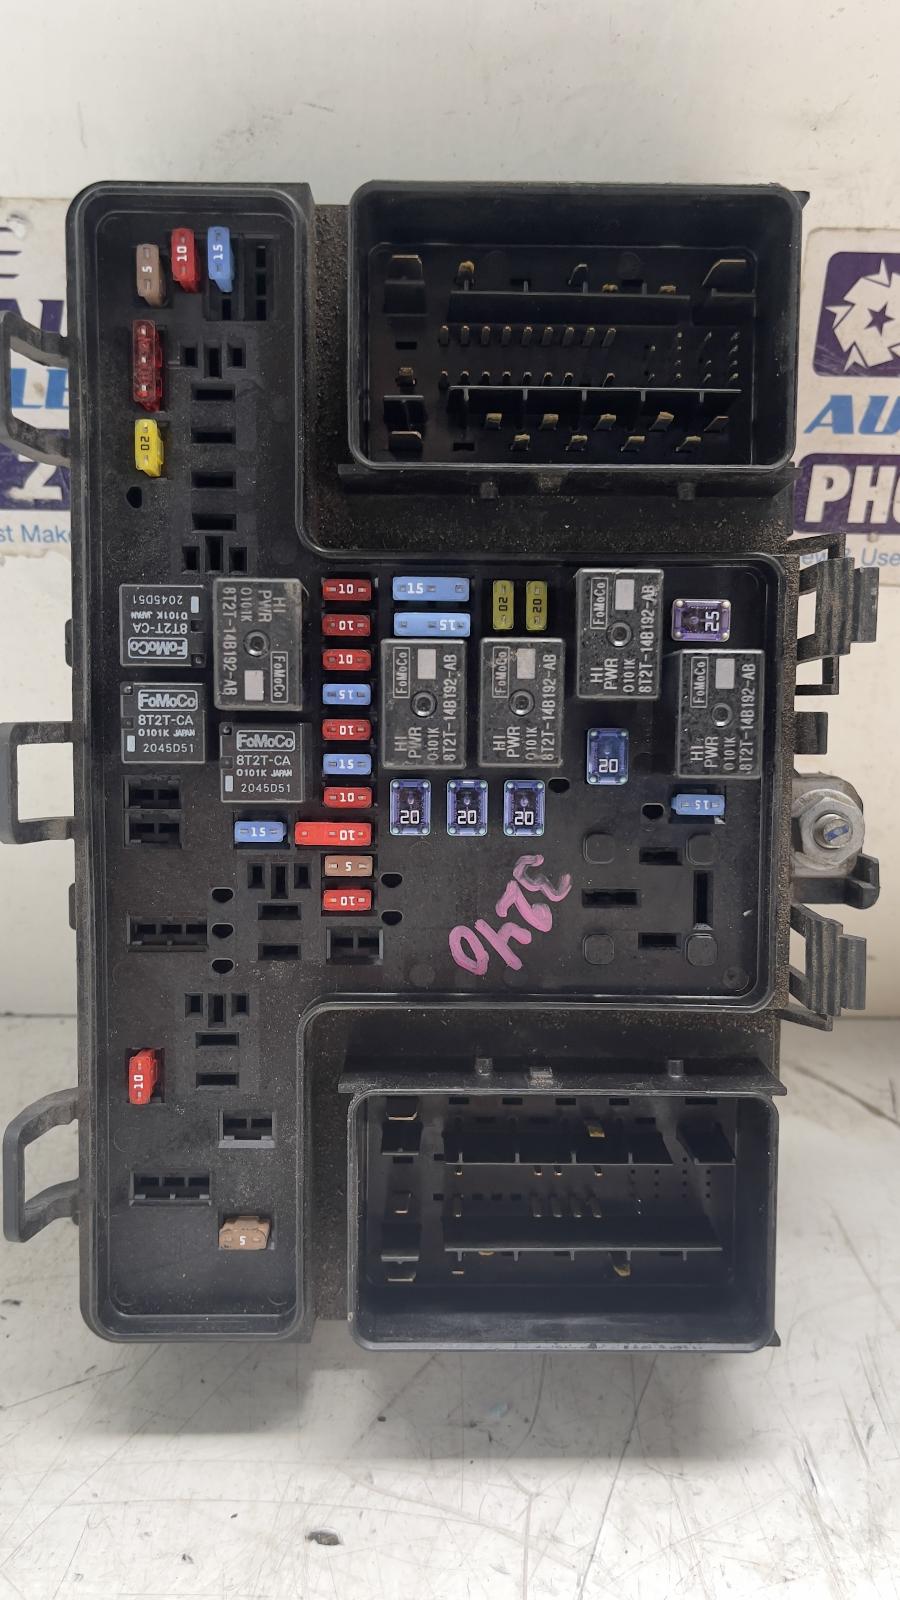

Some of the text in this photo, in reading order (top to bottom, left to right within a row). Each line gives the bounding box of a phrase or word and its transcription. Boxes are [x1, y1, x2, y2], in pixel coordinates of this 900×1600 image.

[177, 246, 187, 261] 10
[213, 244, 223, 260] 15
[142, 265, 152, 274] 5
[141, 436, 150, 451] 20
[805, 464, 900, 524] PH
[338, 584, 354, 594] 10
[407, 582, 424, 594] 15
[133, 594, 183, 605] 2045D51
[258, 590, 272, 623] PWR
[272, 597, 286, 614] HI
[498, 596, 508, 612] 20
[532, 598, 542, 613] 20
[592, 582, 606, 626] FoMoCo
[131, 611, 153, 619] JAPAN
[705, 611, 720, 632] 25
[133, 622, 188, 634] 8T2T-CA
[339, 620, 354, 630] 10
[439, 620, 456, 630] 15
[222, 587, 237, 696] 8T2T-14B192-AB
[640, 584, 656, 694] 8T2T-14B192-AB
[130, 641, 187, 655] FoMoCo
[338, 654, 353, 664] 10
[274, 656, 286, 698] FoMoCo
[396, 651, 408, 694] FoMoCo
[494, 651, 507, 694] FoMoCo
[590, 666, 603, 684] HI
[604, 658, 618, 690] PWR
[692, 661, 706, 705] FoMoCo
[138, 693, 197, 708] FoMoCo
[339, 690, 354, 700] 15
[442, 654, 457, 762] 8T2T-14B192-AB
[541, 654, 556, 761] 8T2T-14B192-AB
[138, 714, 194, 726] 8T2T-CA
[740, 664, 756, 771] 8T2T-14B192-AB
[173, 728, 196, 738] JAPAN
[340, 725, 354, 736] 10
[144, 743, 194, 753] 2045D51
[238, 734, 294, 748] FoMoCo
[394, 736, 407, 752] HI
[408, 726, 422, 758] PWR
[492, 734, 506, 750] HI
[506, 726, 520, 758] PWR
[690, 744, 704, 762] HI
[704, 736, 718, 768] PWR
[236, 754, 290, 766] 8T2T-CA
[339, 760, 354, 769] 15
[598, 758, 618, 772] 20
[271, 768, 292, 777] JAPAN
[240, 783, 291, 793] 2045D51
[340, 792, 354, 802] 10
[696, 800, 710, 810] 15
[400, 810, 420, 824] 20
[457, 810, 477, 824] 20
[514, 811, 534, 826] 20
[251, 827, 266, 837] 15
[339, 830, 354, 840] 10
[346, 862, 352, 872] 5
[340, 896, 355, 906] 10
[134, 1074, 144, 1089] 10
[240, 1236, 246, 1246] 5
